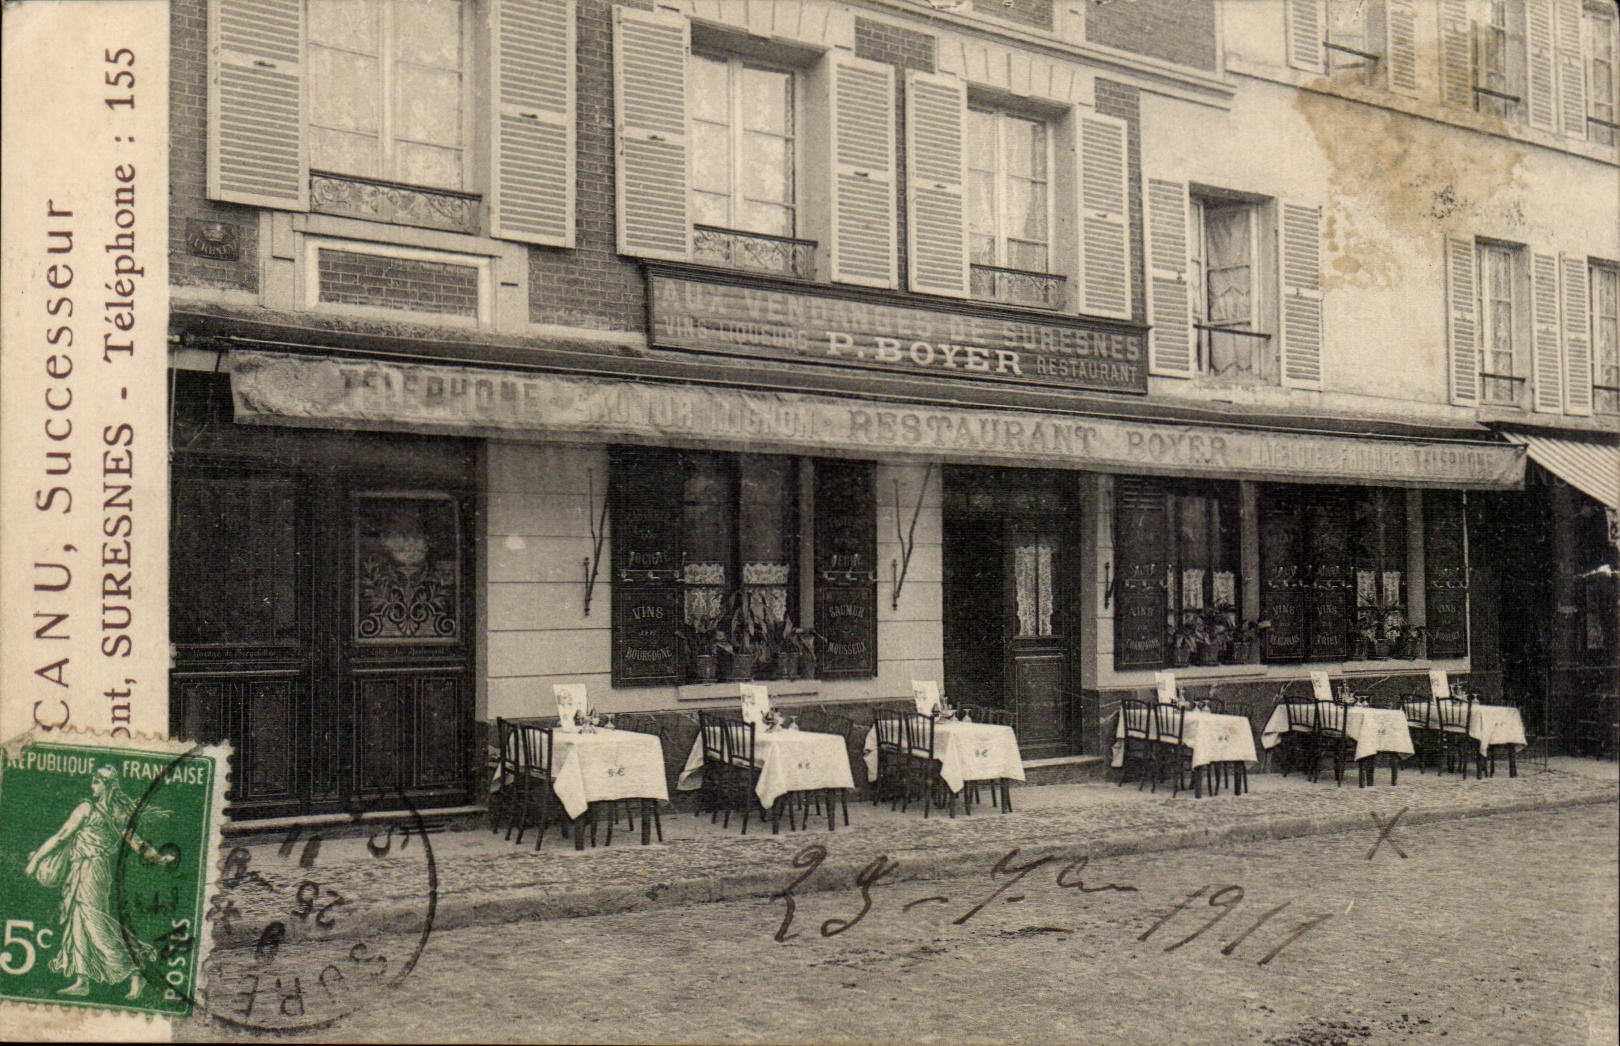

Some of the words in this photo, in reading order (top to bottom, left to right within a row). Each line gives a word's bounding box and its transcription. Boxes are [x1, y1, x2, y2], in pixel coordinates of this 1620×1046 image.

[664, 315, 708, 340] VINS
[950, 317, 986, 344] DE
[1002, 322, 1141, 362] SURESNES
[1037, 354, 1137, 384] RESTAURANT
[847, 408, 1098, 456] RESTAURANT
[1126, 429, 1231, 465] BOYER
[632, 606, 664, 619] VINS
